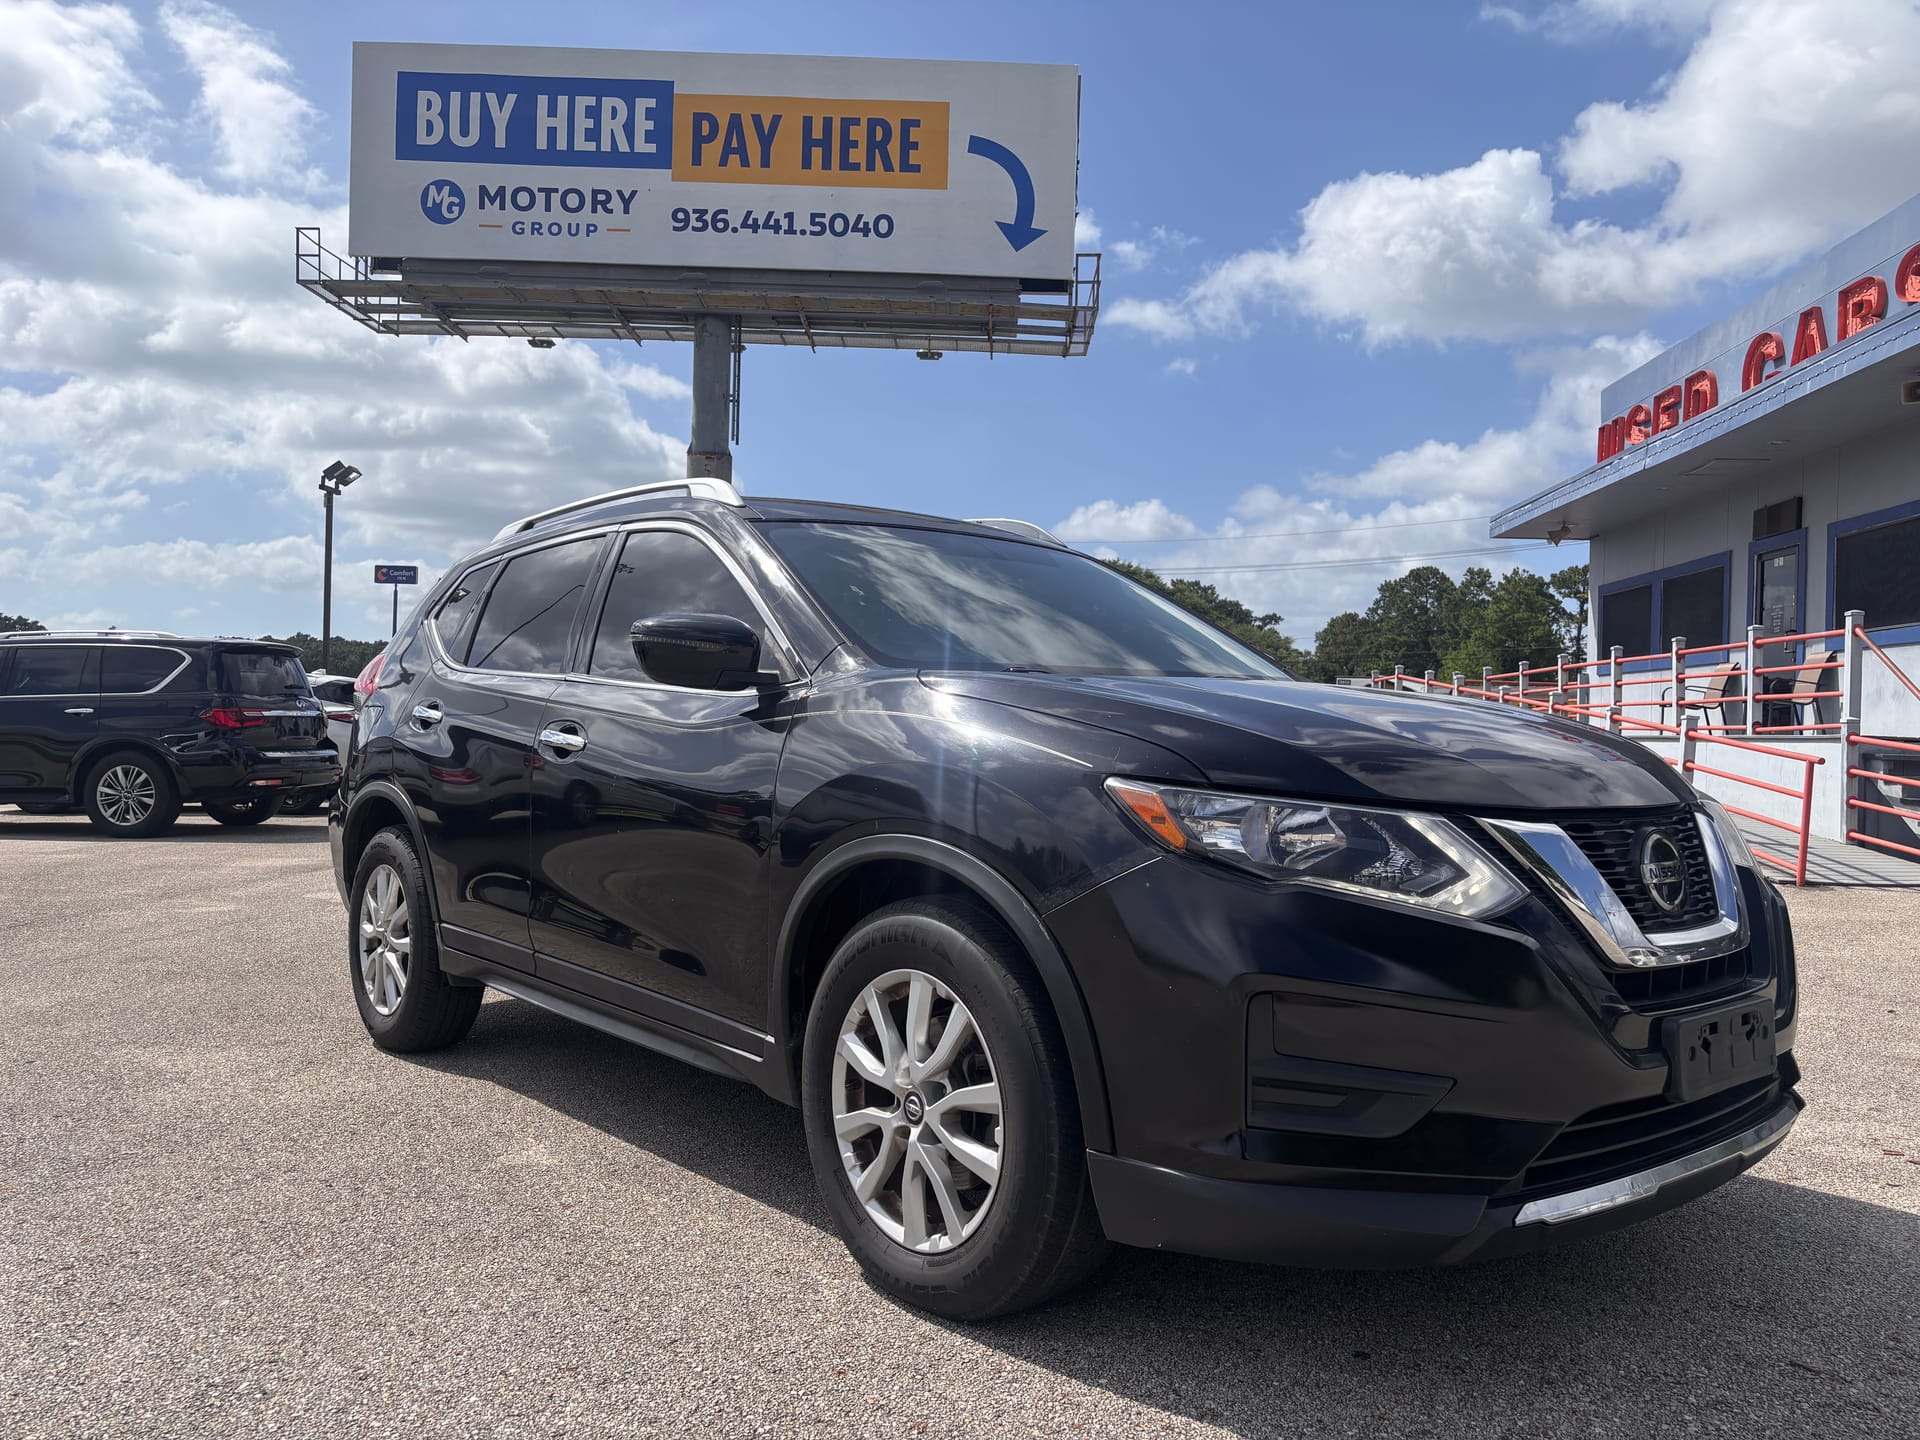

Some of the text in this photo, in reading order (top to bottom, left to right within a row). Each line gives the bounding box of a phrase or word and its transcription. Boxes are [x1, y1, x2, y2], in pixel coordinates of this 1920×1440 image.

[416, 90, 657, 153] BUY HERE
[691, 111, 921, 173] PAY HERE
[426, 184, 461, 219] MG
[478, 184, 638, 215] MOTORY
[511, 221, 598, 237] GROUP
[671, 207, 895, 238] 936.441.5040
[389, 569, 414, 577] Comfort
